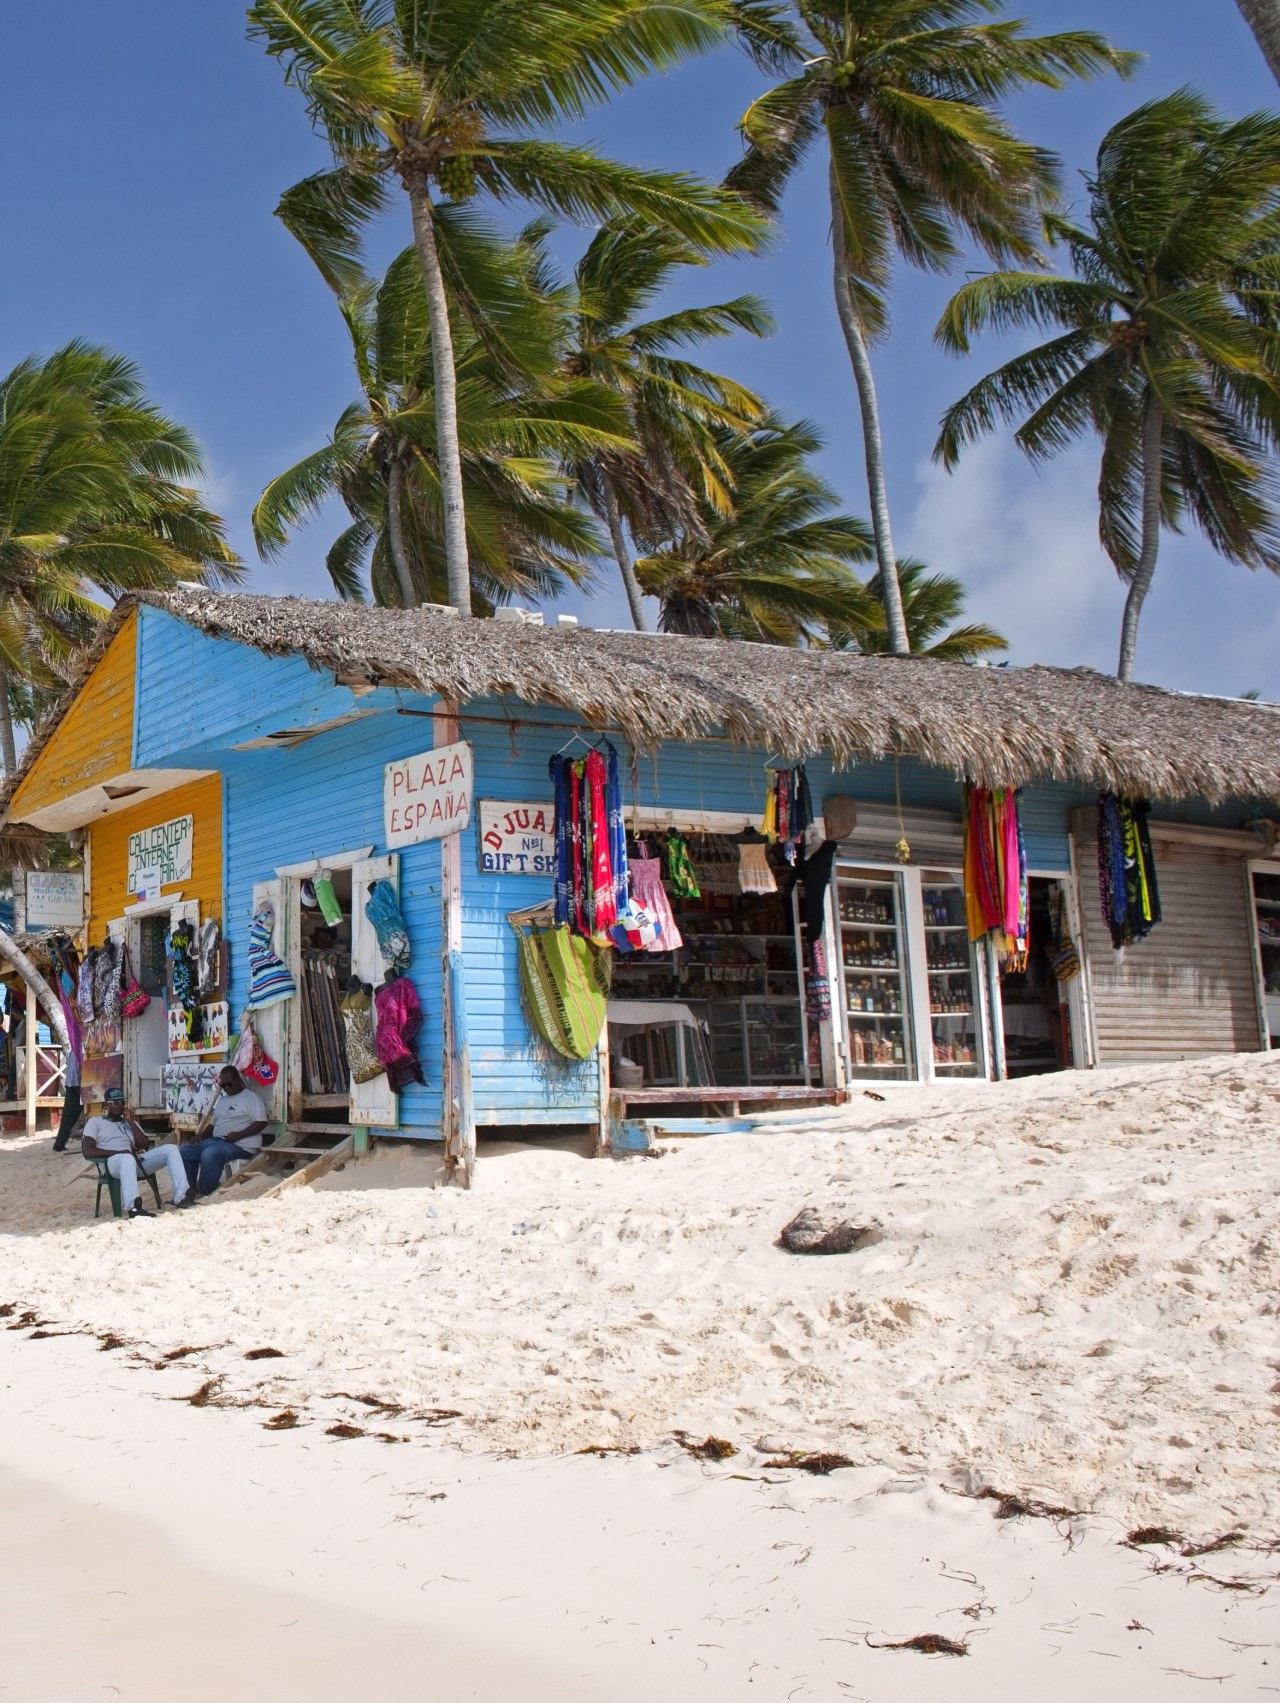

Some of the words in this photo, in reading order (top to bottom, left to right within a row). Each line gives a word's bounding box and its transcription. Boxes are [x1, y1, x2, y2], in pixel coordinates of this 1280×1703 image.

[393, 754, 464, 797] PLAZA
[390, 790, 469, 833] ESPAÑA
[129, 831, 150, 856] CALL
[150, 818, 188, 850] CENTER
[134, 841, 181, 872] INTERNET
[482, 852, 528, 871] GIFT
[533, 854, 557, 873] SH
